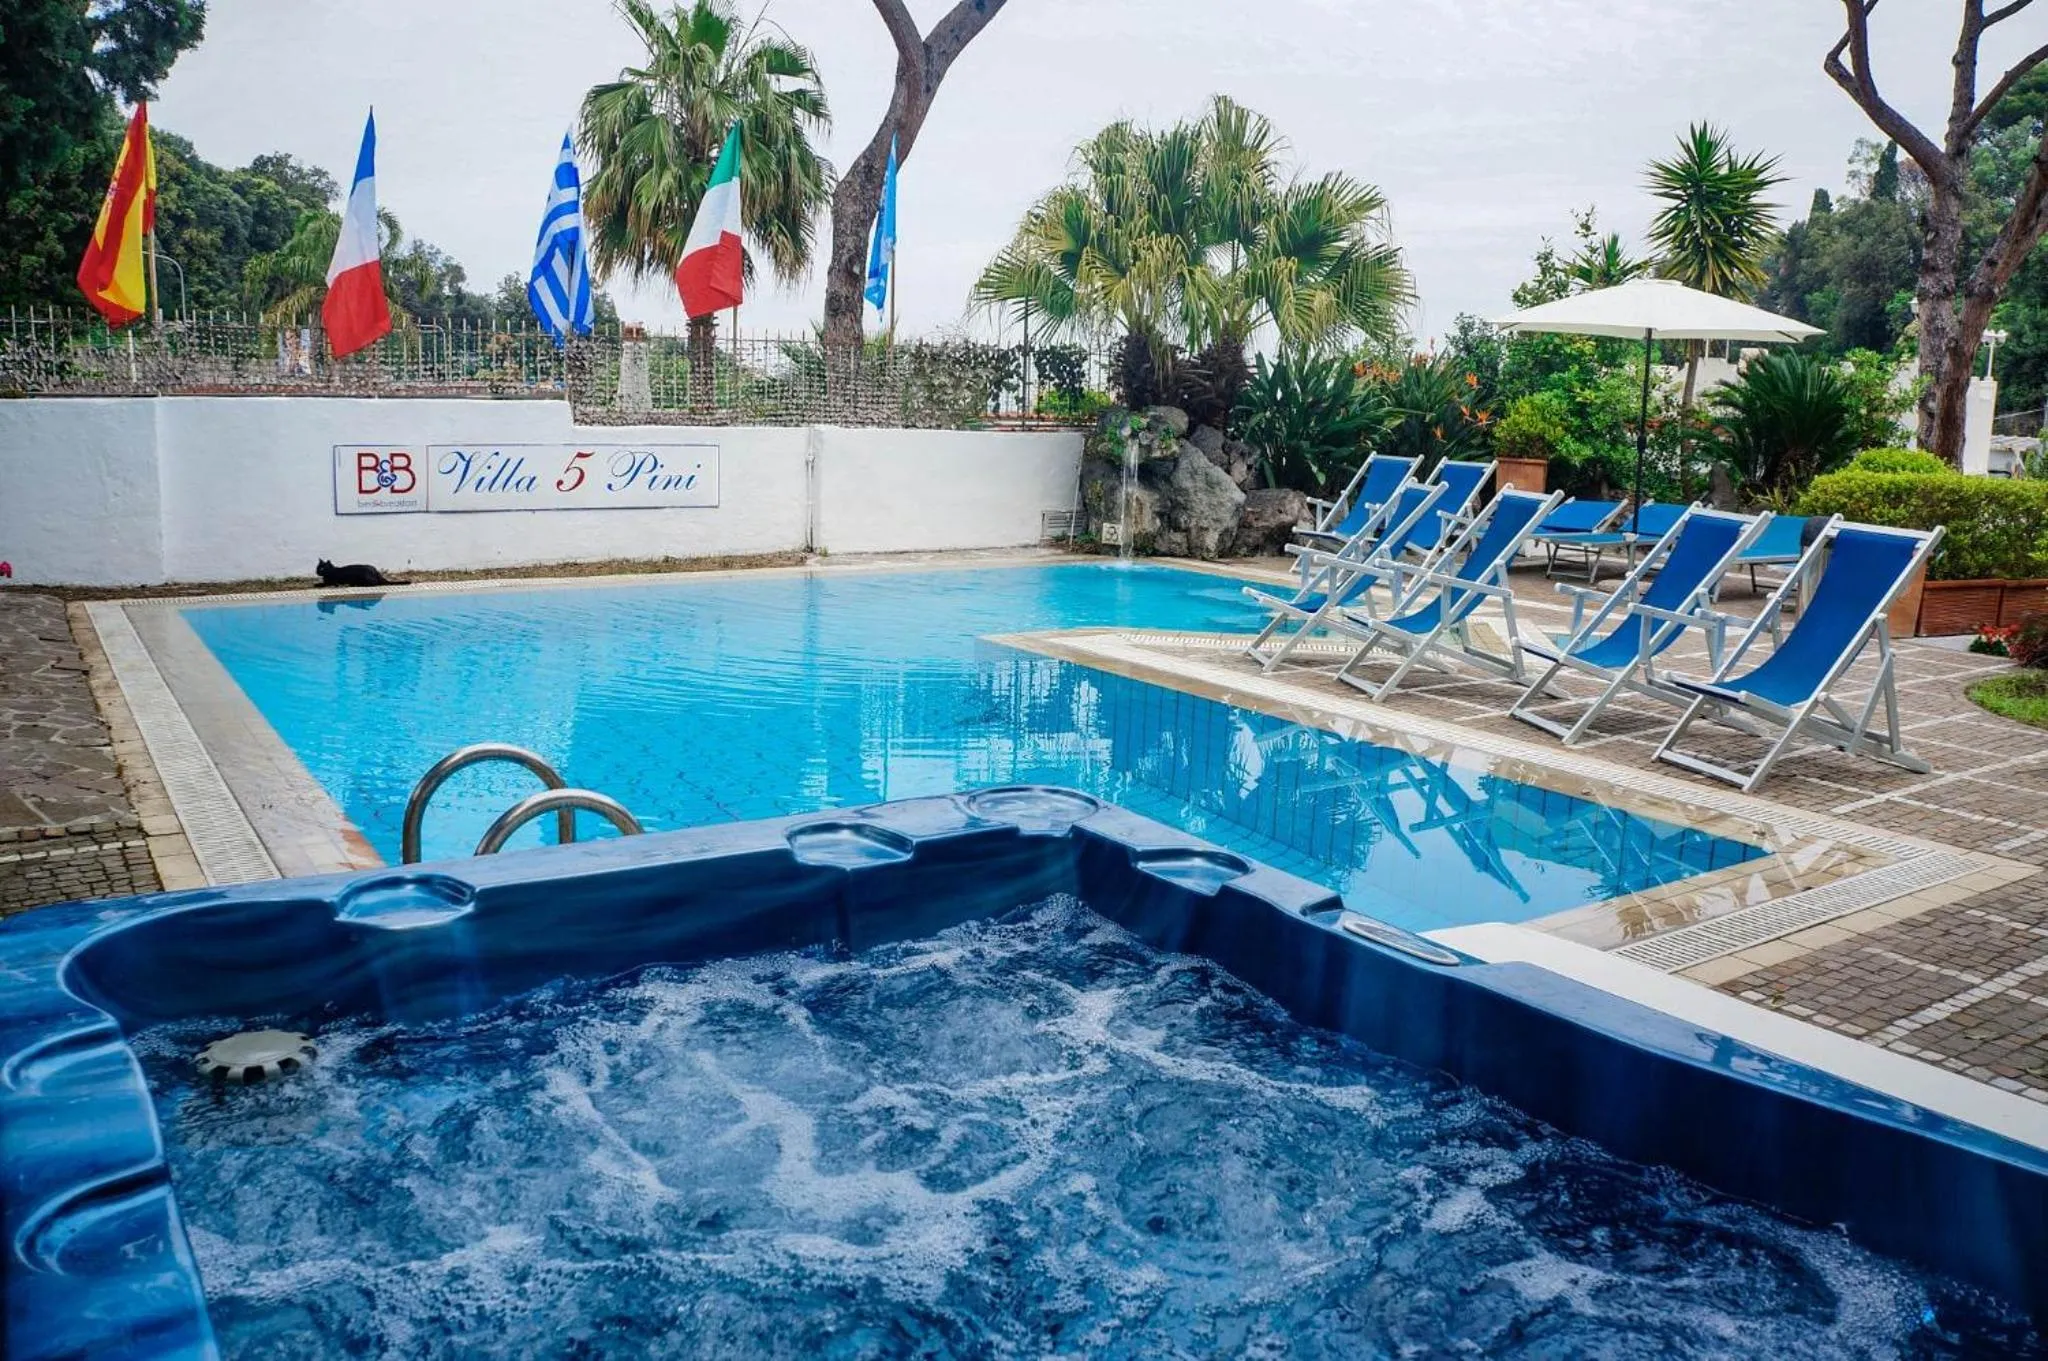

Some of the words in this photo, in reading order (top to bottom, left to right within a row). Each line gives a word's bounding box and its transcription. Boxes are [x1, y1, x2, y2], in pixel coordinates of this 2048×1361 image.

[357, 453, 416, 494] B&B
[437, 450, 538, 494] Villa
[556, 451, 595, 492] 5
[606, 450, 702, 492] Pini
